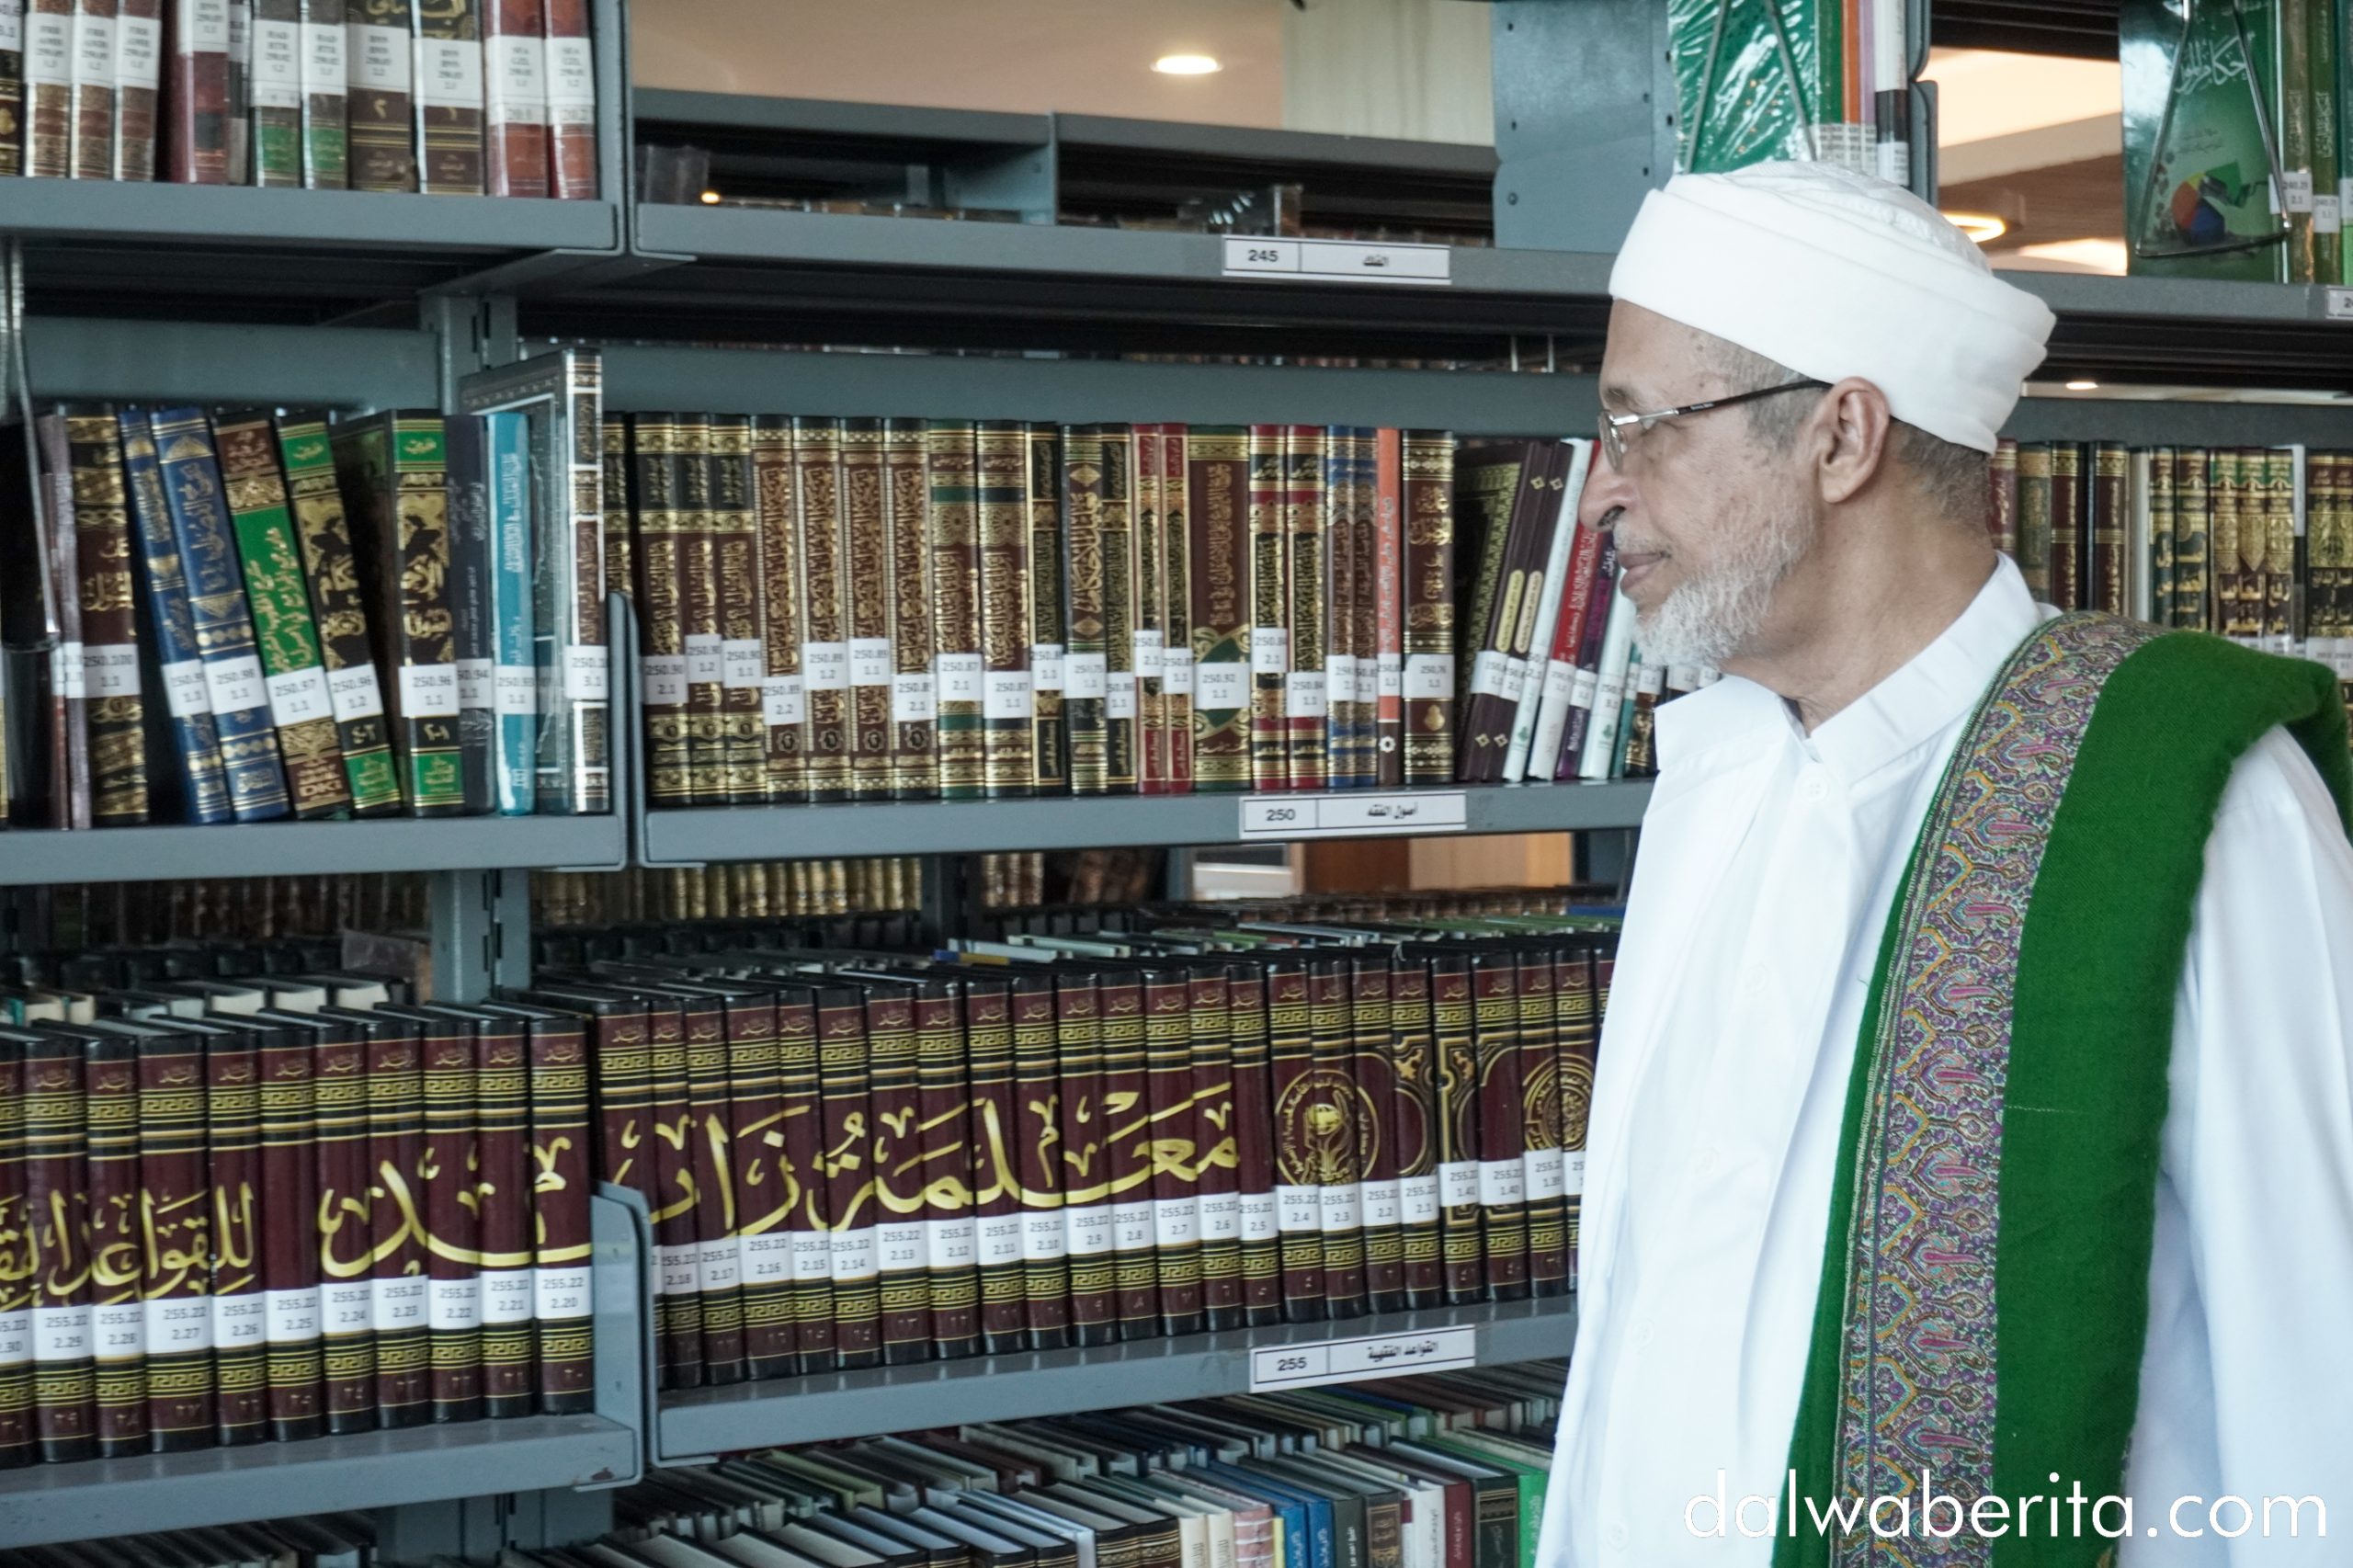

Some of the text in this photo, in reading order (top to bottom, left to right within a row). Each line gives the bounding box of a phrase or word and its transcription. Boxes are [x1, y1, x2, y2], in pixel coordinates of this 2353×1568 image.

[1248, 249, 1279, 262] 245
[1143, 654, 1159, 665] 2.1
[1264, 653, 1280, 665] 2.1
[457, 669, 489, 680] 50.94
[1040, 669, 1056, 680] 1.1
[1173, 672, 1188, 683] 1.1
[952, 680, 969, 691] 2.1
[1211, 689, 1227, 699] 1.1
[908, 701, 926, 712] 2.1
[1005, 698, 1021, 709] 1.1
[1302, 696, 1318, 706] 1.1
[775, 703, 793, 715] 2.2
[1266, 808, 1296, 822] 250
[1367, 803, 1391, 817] الفقه
[1284, 1194, 1318, 1205] 255.22
[1160, 1205, 1195, 1218] 255.22
[1204, 1200, 1237, 1213] 255.22
[1239, 1202, 1273, 1214] 255.22
[1379, 1207, 1392, 1218] 2.2
[1416, 1203, 1432, 1214] 2.1
[1075, 1214, 1109, 1228] 255.22
[1115, 1210, 1149, 1223] 255.22
[1292, 1212, 1310, 1222] 2.4
[1334, 1212, 1350, 1222] 2.3
[985, 1223, 1019, 1236] 255.22
[1172, 1224, 1188, 1235] 2.7
[1215, 1220, 1231, 1231] 2.6
[1250, 1221, 1267, 1232] 2.5
[883, 1230, 920, 1242] 255.22
[1086, 1234, 1103, 1245] 2.9
[1126, 1230, 1142, 1241] 2.8
[749, 1238, 787, 1251] 255.22
[794, 1241, 829, 1252] 255.22
[831, 1238, 870, 1253] 255.22
[994, 1243, 1016, 1255] 2.11
[702, 1248, 738, 1263] 255.22
[890, 1248, 915, 1260] 2.13
[757, 1263, 780, 1274] 2.16
[801, 1259, 826, 1271] 2.15
[841, 1258, 866, 1270] 2.14
[710, 1268, 733, 1280] 2.17
[491, 1278, 529, 1291] 255.22
[543, 1277, 585, 1290] 255.22
[332, 1290, 370, 1302] 255.22
[384, 1286, 424, 1299] 255.22
[438, 1287, 477, 1299] 255.22
[277, 1297, 317, 1311] 255.22
[498, 1300, 524, 1311] 2.21
[551, 1297, 579, 1309] 2.20
[163, 1306, 207, 1320] 255.22
[223, 1302, 263, 1317] 255.22
[445, 1307, 472, 1319] 2.22
[45, 1314, 89, 1328] 255.22
[99, 1312, 143, 1325] 255.22
[340, 1310, 367, 1323] 2.24
[286, 1318, 313, 1330] 2.25
[172, 1327, 201, 1340] 2.27
[53, 1335, 84, 1348] 2.29
[1368, 1341, 1438, 1363] القواعد الفقهية
[1277, 1357, 1307, 1371] 255
